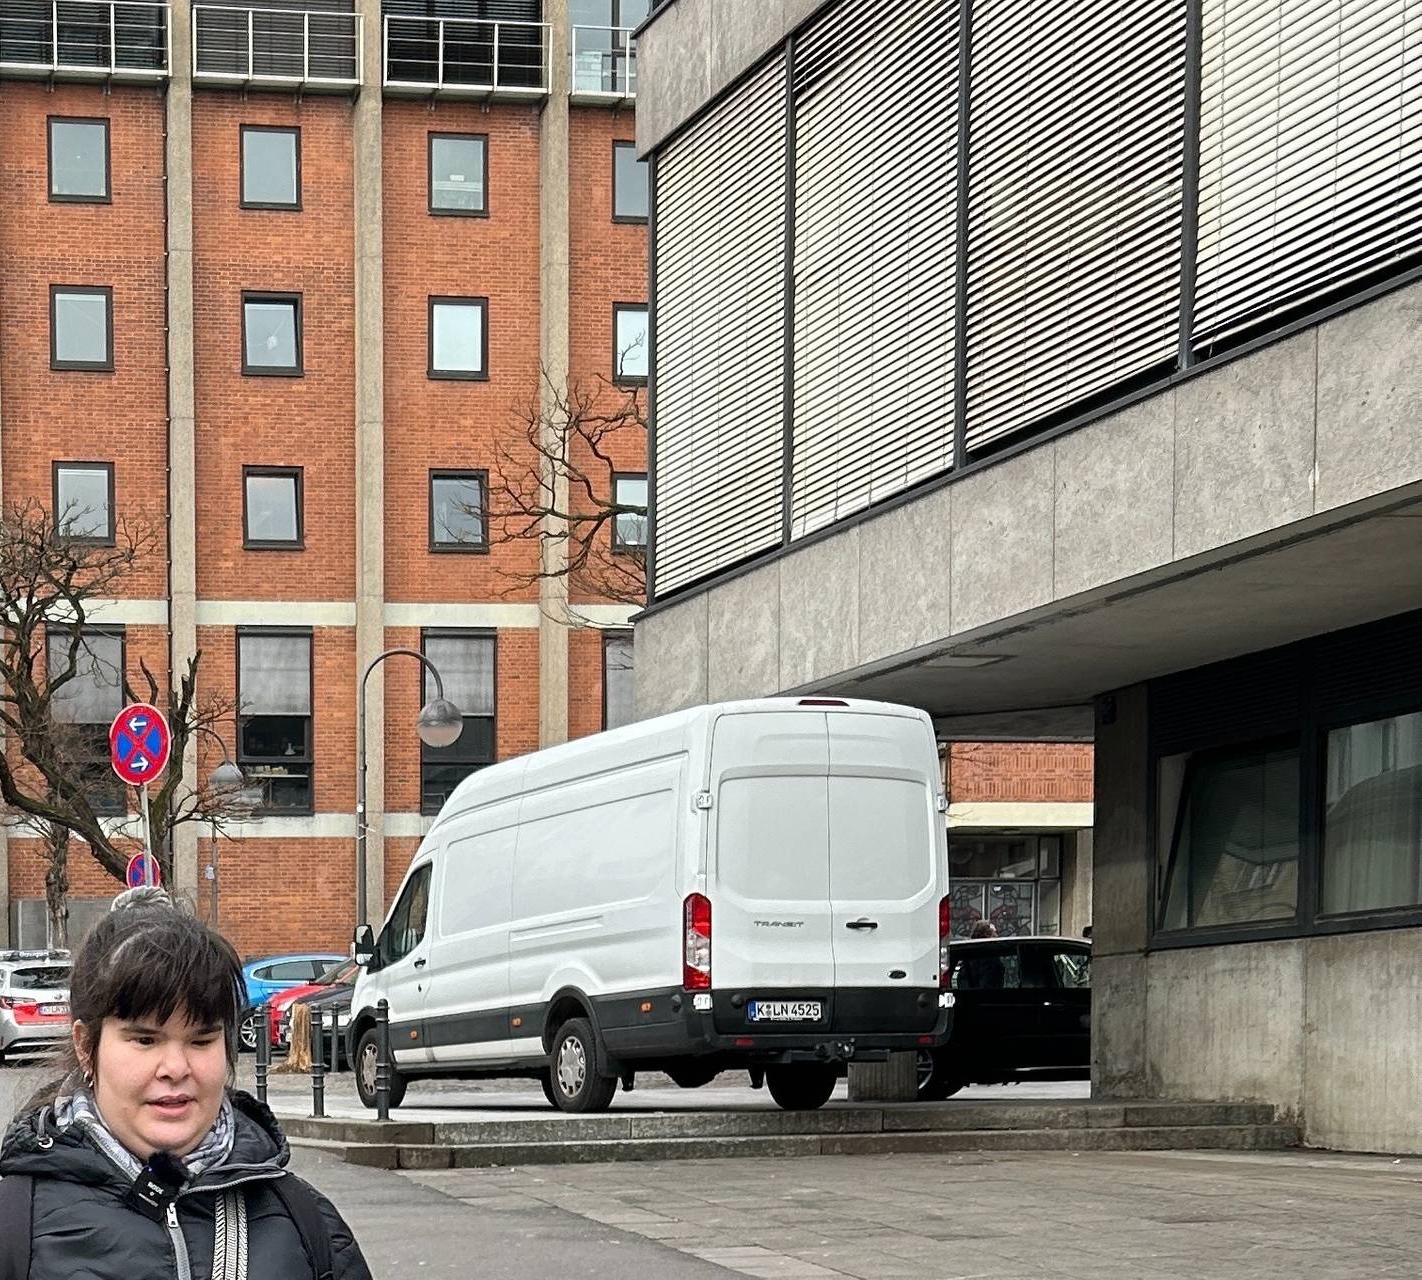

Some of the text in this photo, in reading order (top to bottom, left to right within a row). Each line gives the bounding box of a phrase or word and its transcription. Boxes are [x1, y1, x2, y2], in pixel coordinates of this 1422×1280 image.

[753, 920, 805, 928] TRANSIT
[757, 1003, 820, 1016] K LN 4525
